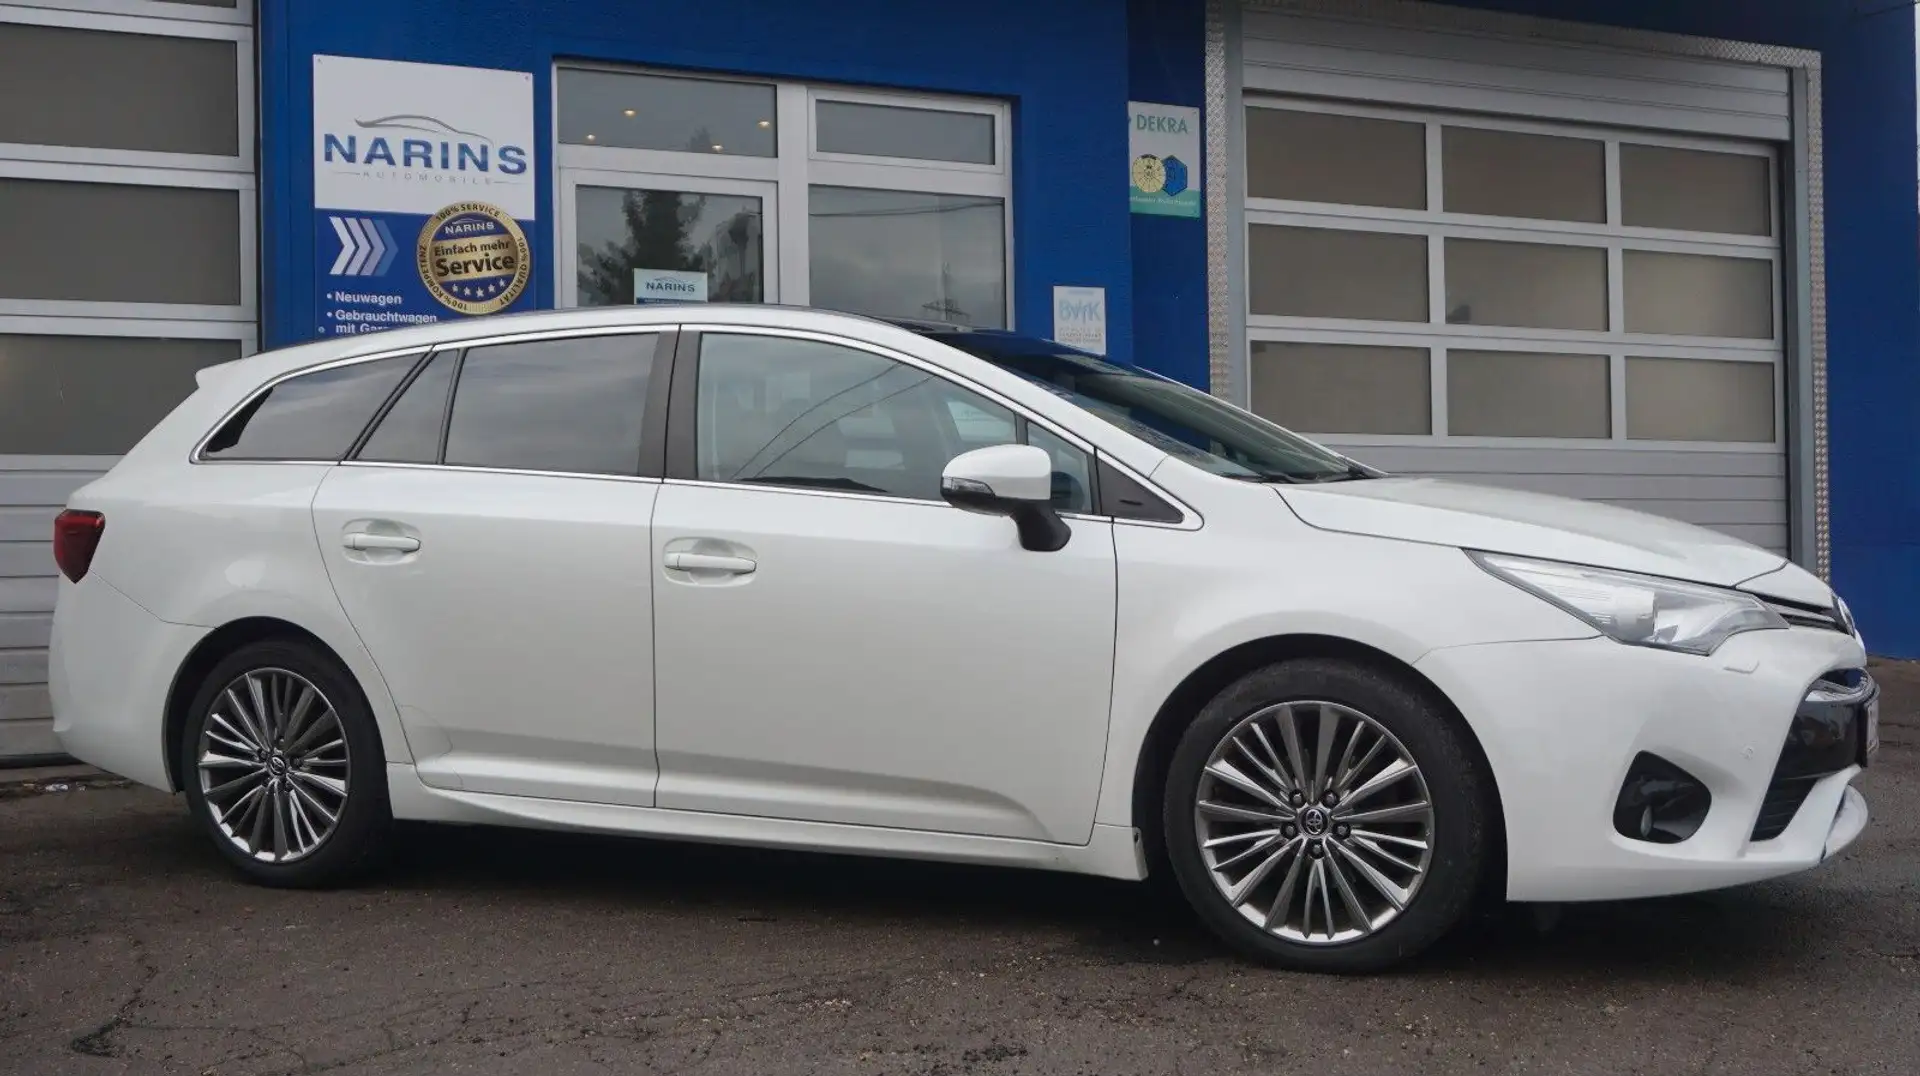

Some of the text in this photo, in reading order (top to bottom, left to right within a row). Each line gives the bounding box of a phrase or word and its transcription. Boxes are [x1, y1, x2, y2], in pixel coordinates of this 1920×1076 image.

[1136, 114, 1188, 134] DEKRA
[324, 133, 527, 174] NARINS
[461, 203, 501, 217] SERVICE
[444, 222, 495, 234] NARINS
[433, 239, 510, 257] Einfach mehr
[435, 252, 515, 277] Service
[646, 281, 696, 293] NARINS
[335, 291, 402, 306] Neuwagen
[335, 309, 438, 324] Gebrauchtwagen
[335, 322, 356, 334] mit
